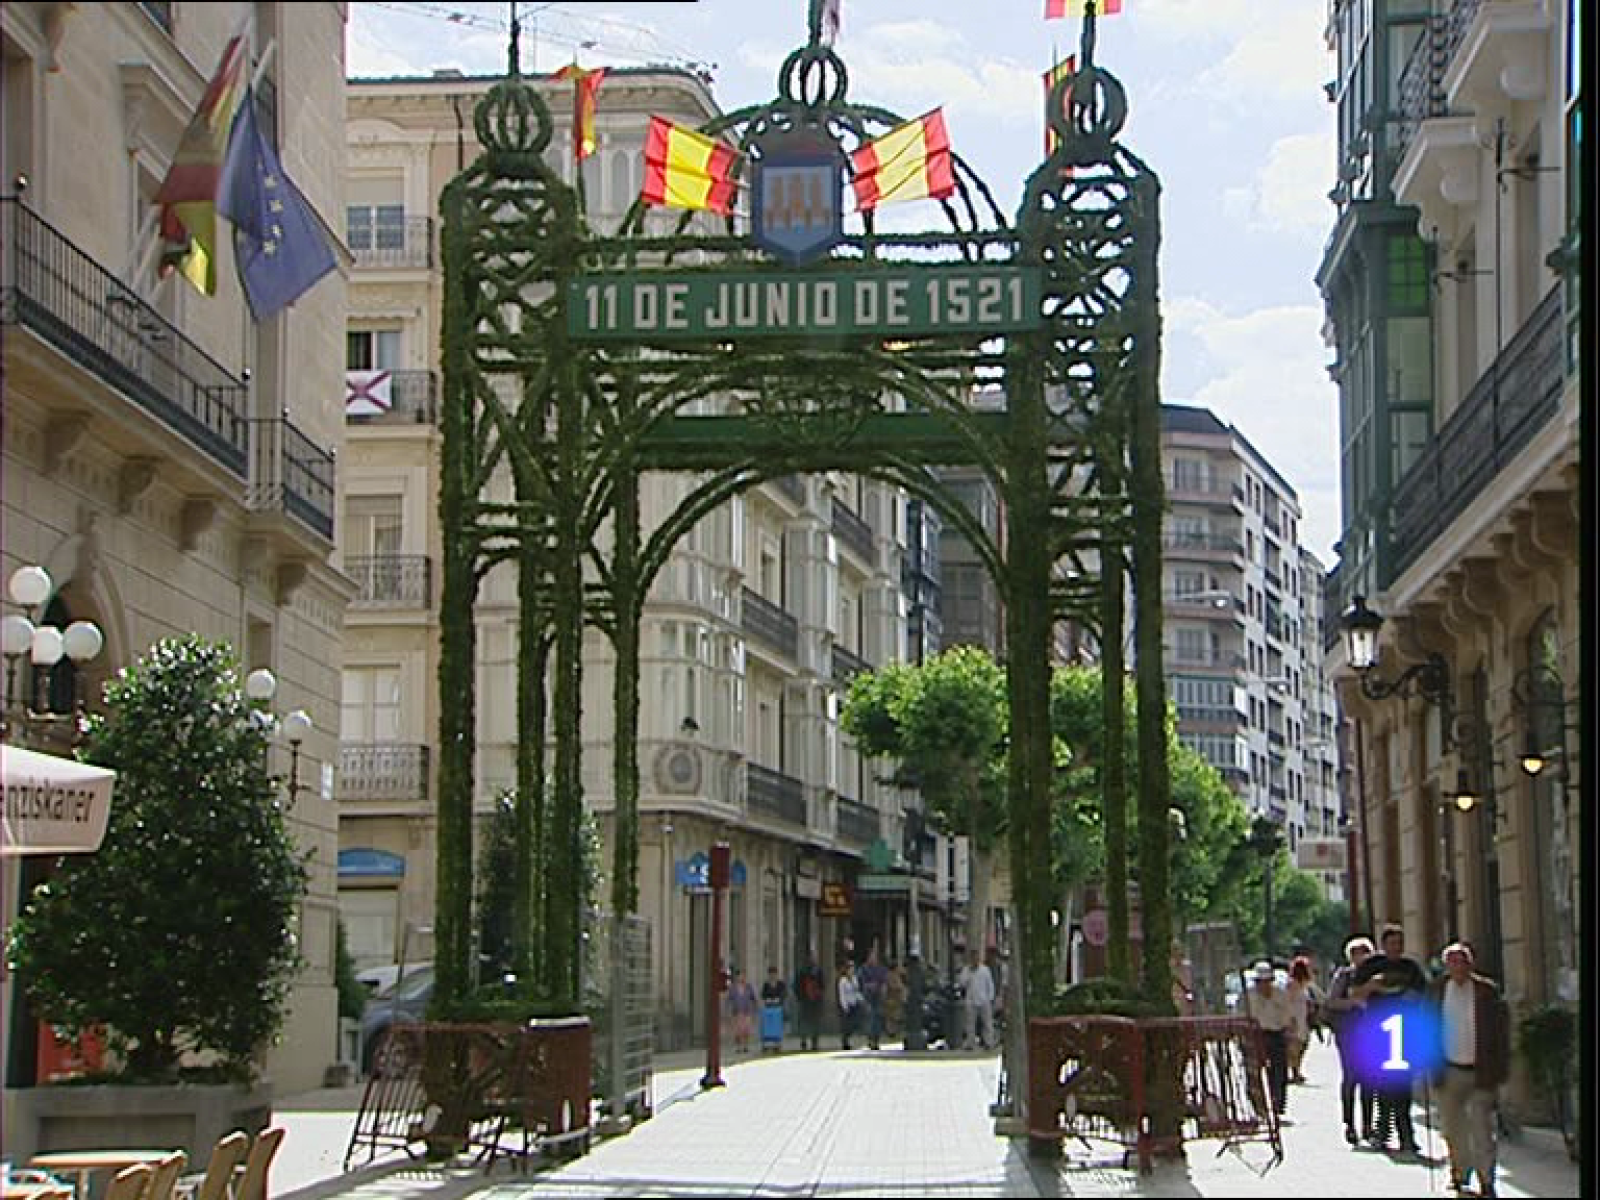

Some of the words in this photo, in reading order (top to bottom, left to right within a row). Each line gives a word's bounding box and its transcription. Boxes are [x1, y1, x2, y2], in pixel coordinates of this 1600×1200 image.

[585, 284, 617, 330] 11
[633, 283, 689, 329] DE
[705, 281, 837, 327] JUNIO
[854, 279, 910, 325] DE
[926, 276, 1022, 325] 1521
